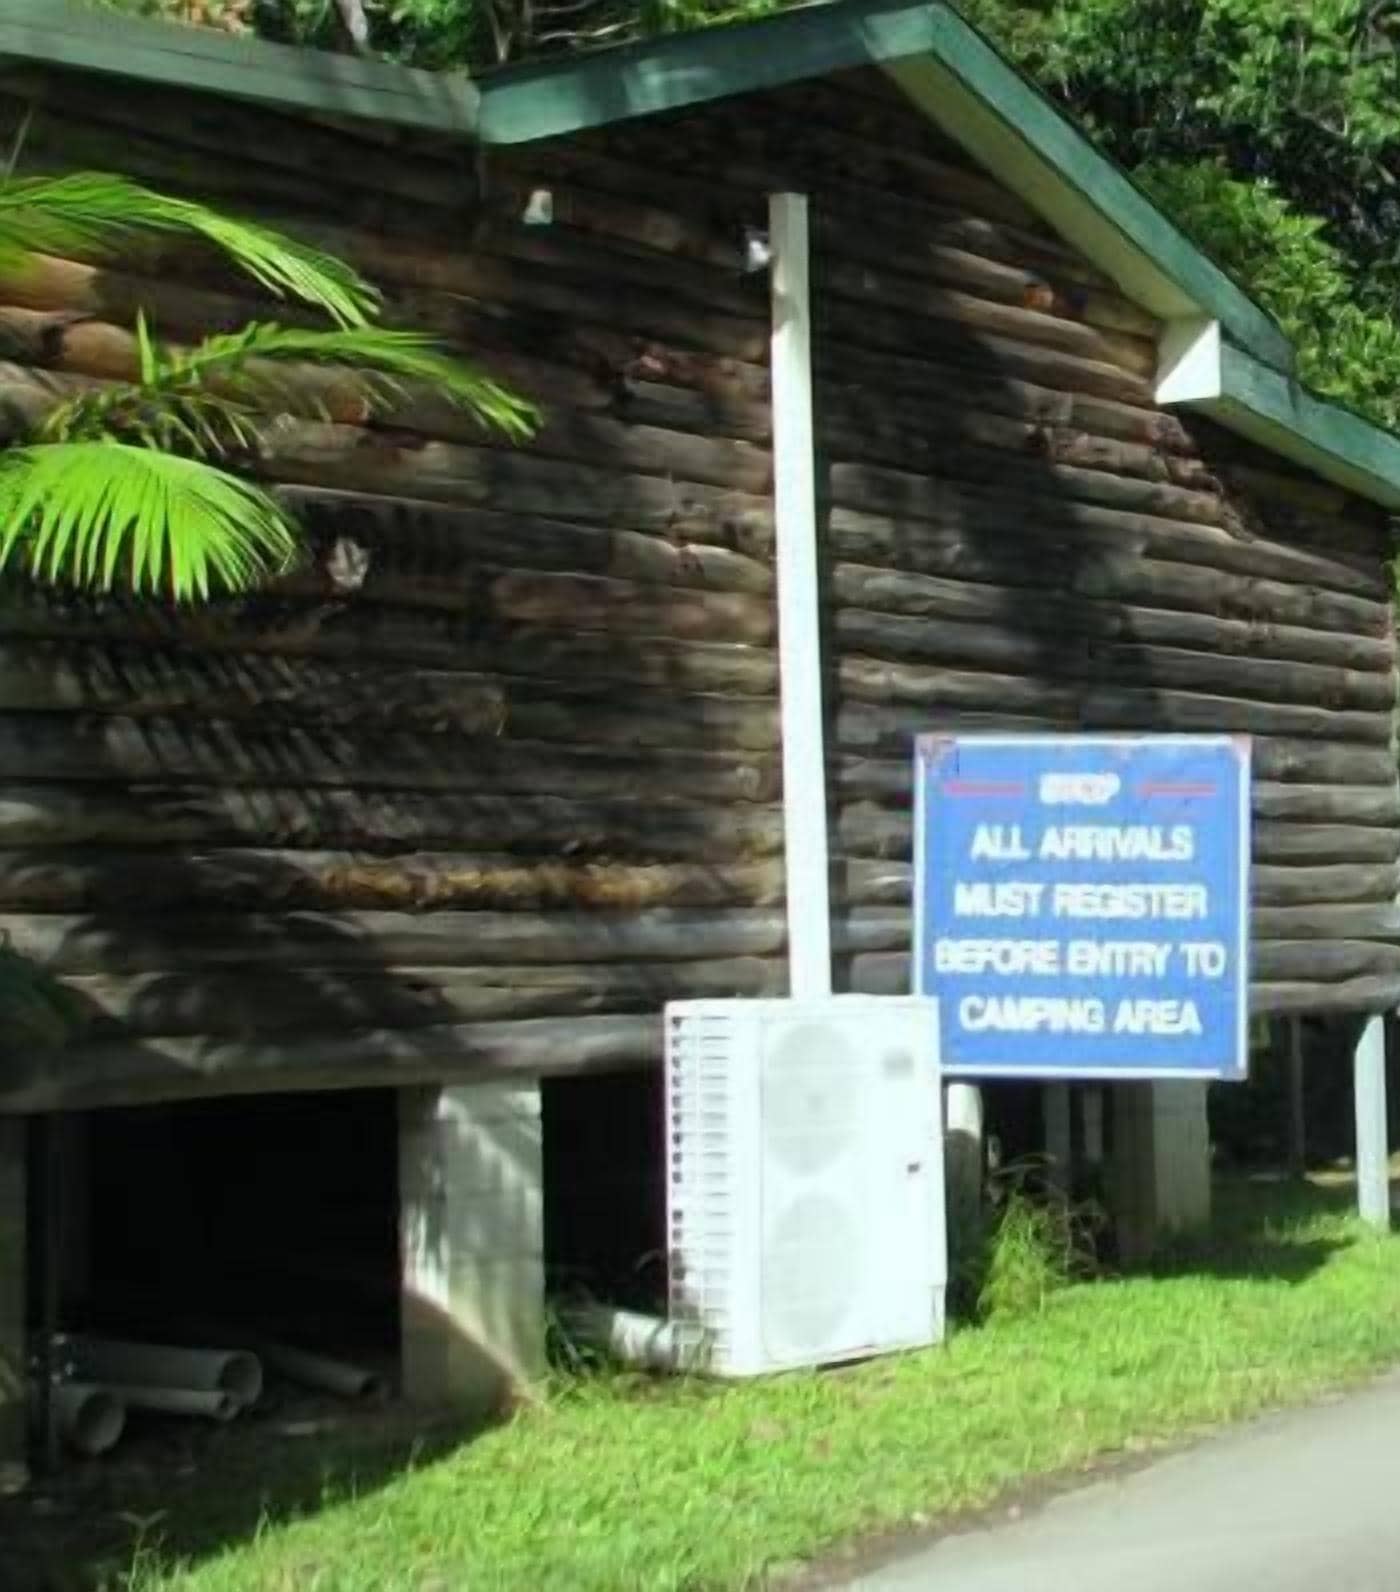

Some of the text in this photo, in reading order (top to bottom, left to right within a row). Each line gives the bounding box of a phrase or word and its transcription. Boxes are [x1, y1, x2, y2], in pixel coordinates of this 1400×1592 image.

[971, 824, 1194, 861] ALL ARRIVALS
[954, 882, 1207, 919] MUST REGISTER
[935, 939, 1226, 977] BEFORE ENTRY TO
[959, 996, 1203, 1035] CAMPING AREA
